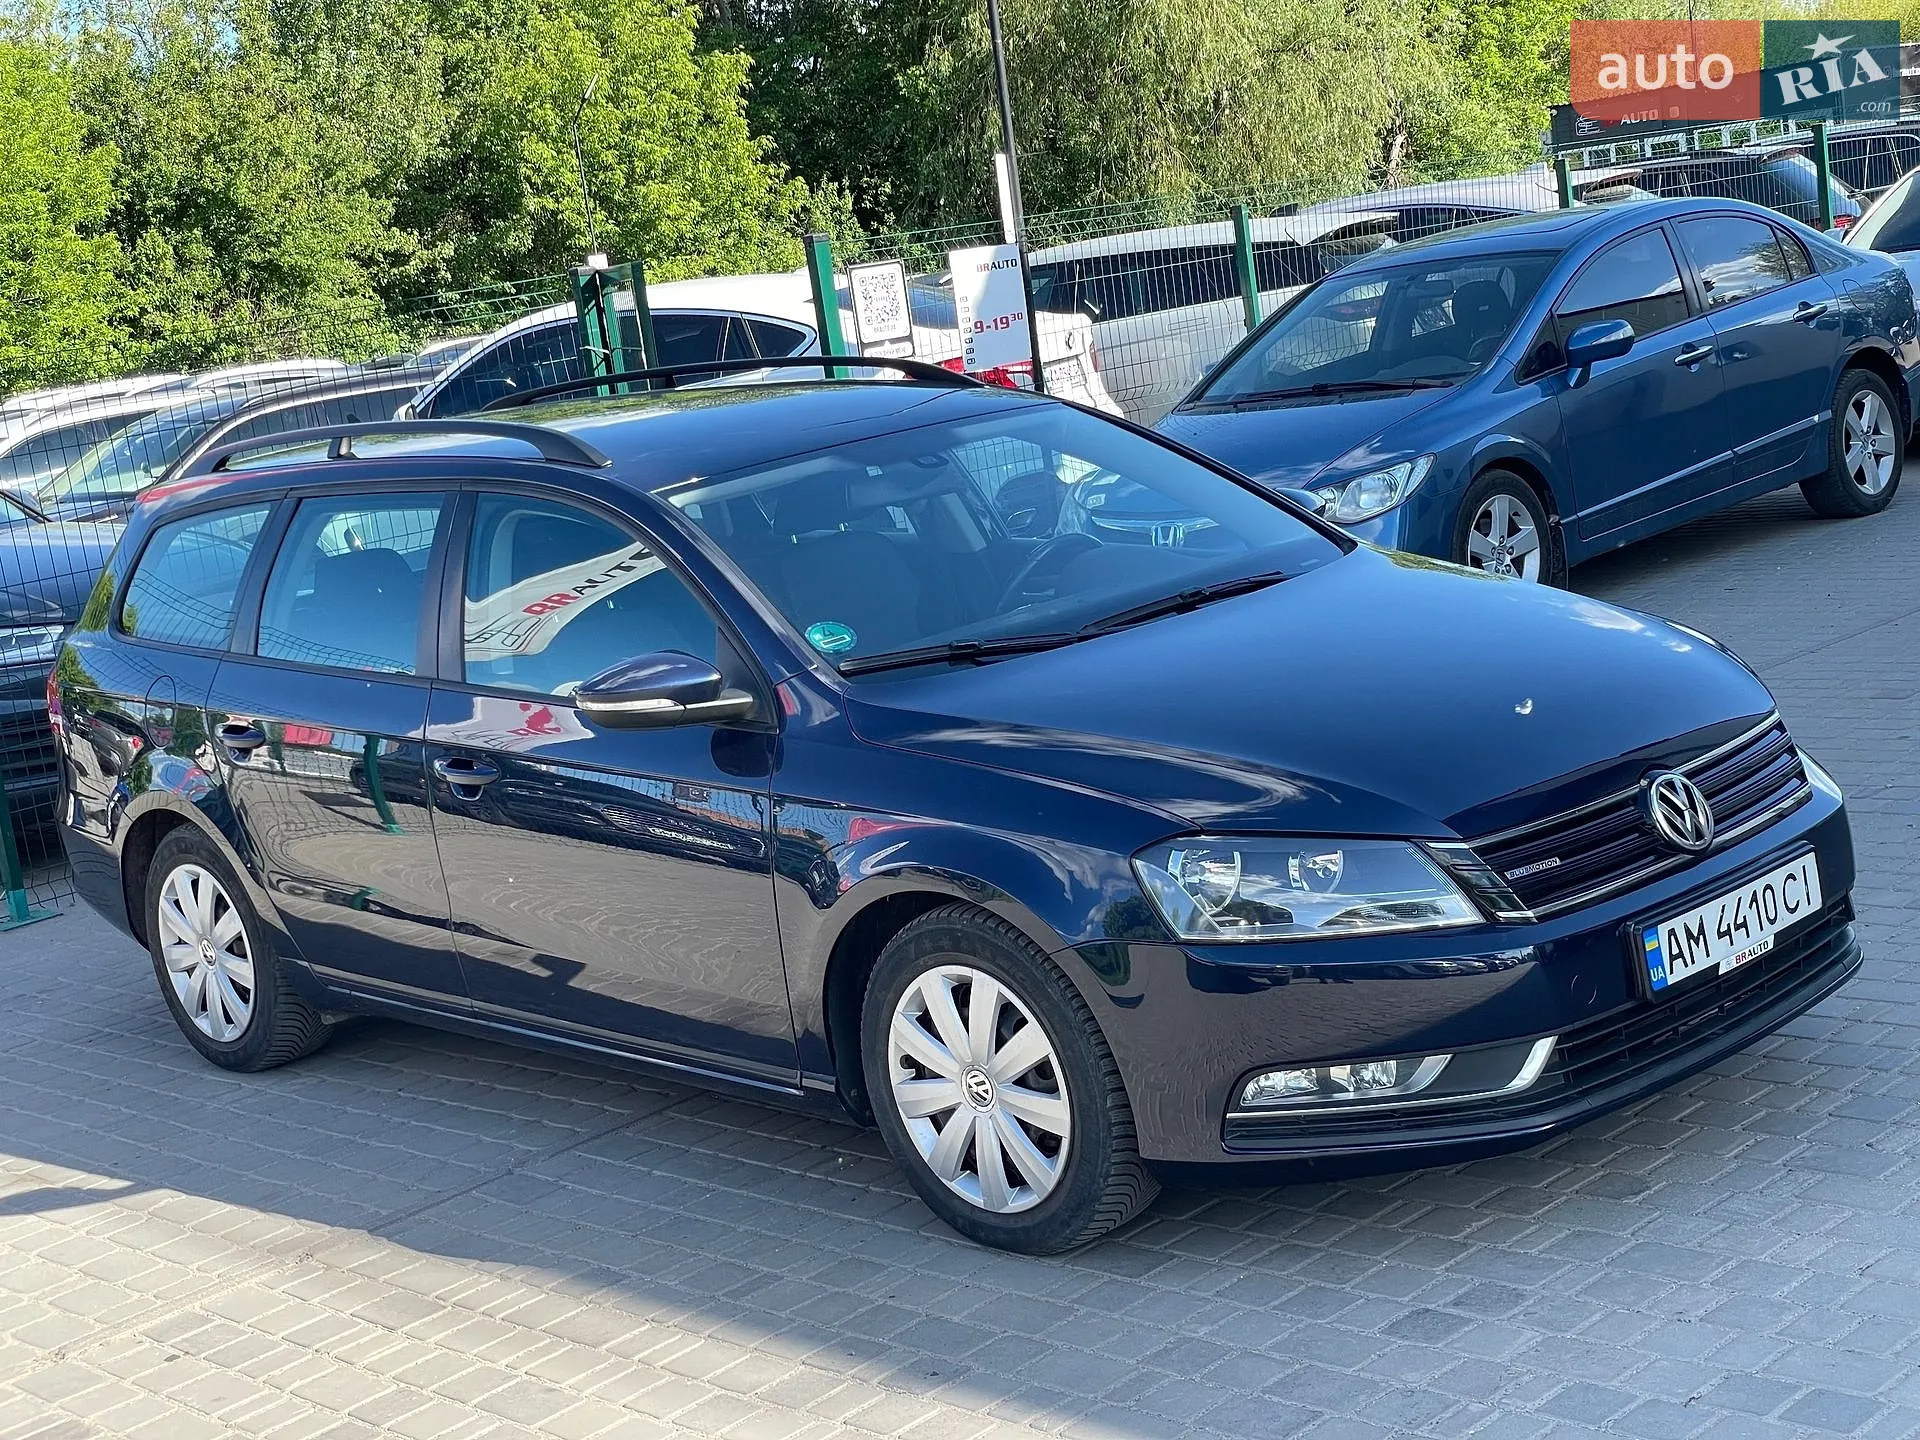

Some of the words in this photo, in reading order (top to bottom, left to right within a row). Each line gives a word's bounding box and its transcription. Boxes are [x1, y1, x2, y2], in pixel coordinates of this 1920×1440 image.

[977, 258, 1018, 273] BRAUTO
[1509, 857, 1558, 879] BLUEMOTION
[1667, 915, 1710, 976] AM
[1716, 883, 1778, 947] 4410
[1734, 940, 1769, 966] BRAUTO
[1650, 965, 1666, 983] UA
